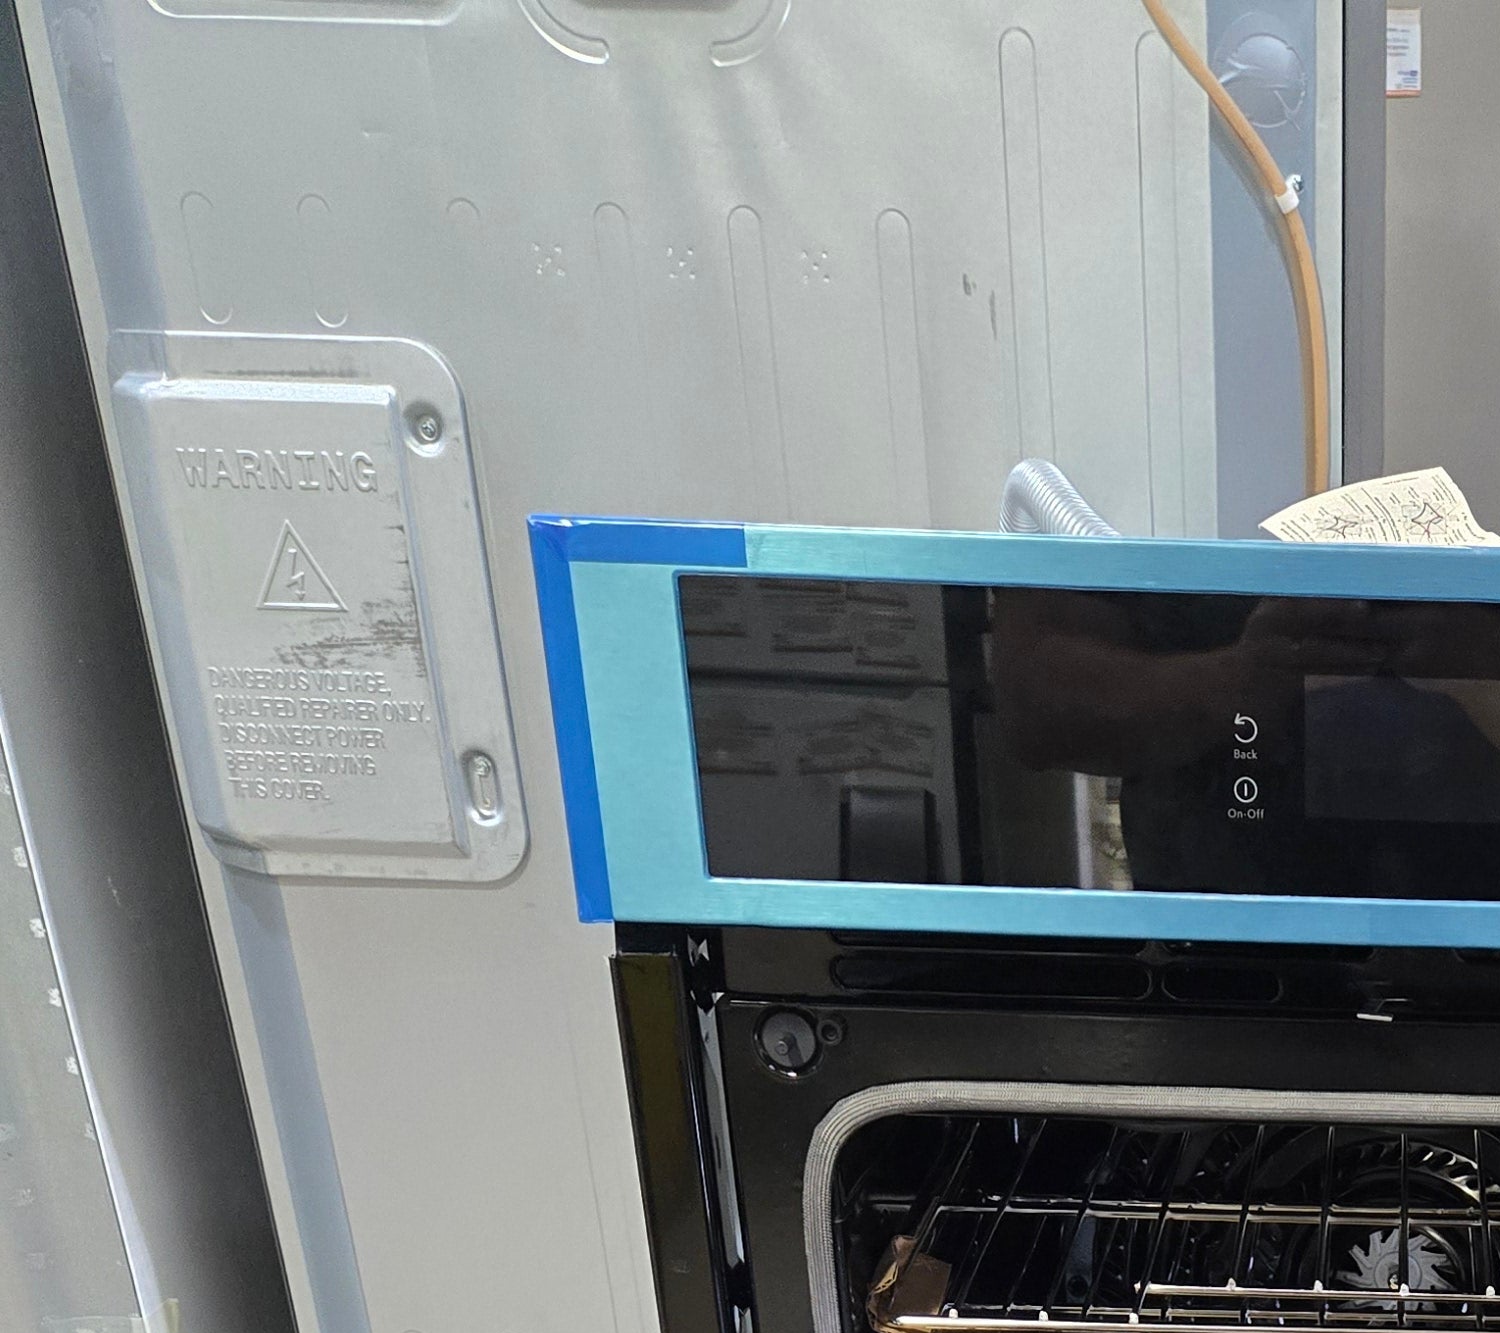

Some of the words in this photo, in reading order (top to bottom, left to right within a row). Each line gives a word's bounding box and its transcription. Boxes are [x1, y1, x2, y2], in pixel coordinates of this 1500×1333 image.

[175, 447, 378, 492] WARNING
[207, 666, 310, 691] DANGEROUS
[310, 670, 392, 696] VOLTAGE,
[214, 694, 297, 720] QUALIFIED
[299, 697, 377, 721] REPAIRER
[382, 700, 431, 723] ONLY.
[218, 722, 322, 747] DISCONNECT
[325, 725, 385, 749] POWER
[223, 749, 289, 773] BEFORE
[290, 752, 377, 776] REMOVING
[1233, 748, 1258, 760] Back
[228, 776, 268, 799] THIS
[271, 778, 330, 801] COVER.
